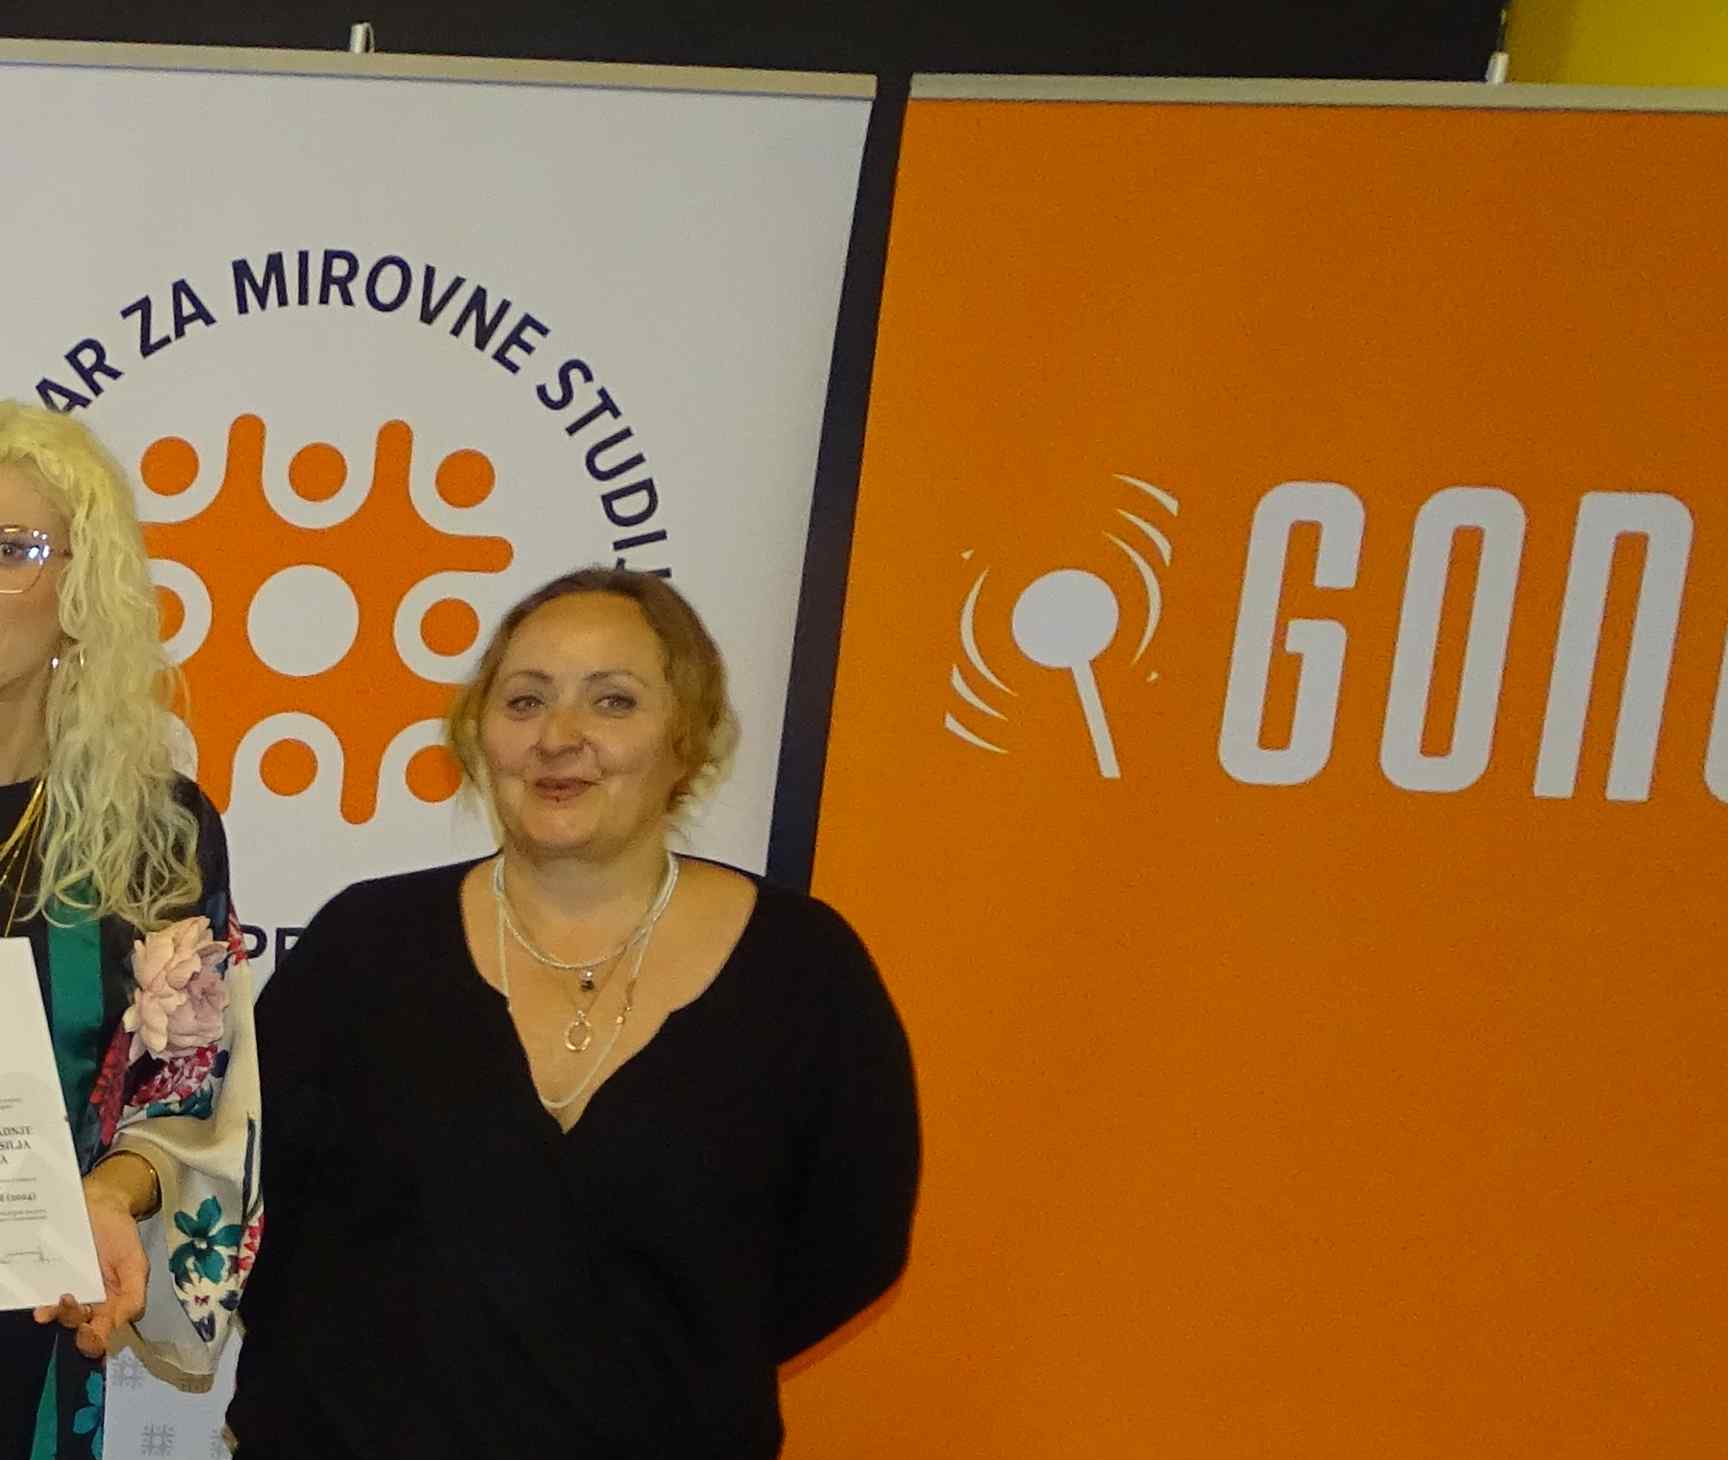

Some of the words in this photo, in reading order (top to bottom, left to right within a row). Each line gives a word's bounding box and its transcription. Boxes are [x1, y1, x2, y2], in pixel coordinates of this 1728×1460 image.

[120, 278, 217, 359] ZA
[231, 249, 551, 375] MIROVNE
[536, 359, 672, 579] STUDI
[1217, 481, 1728, 802] GON
